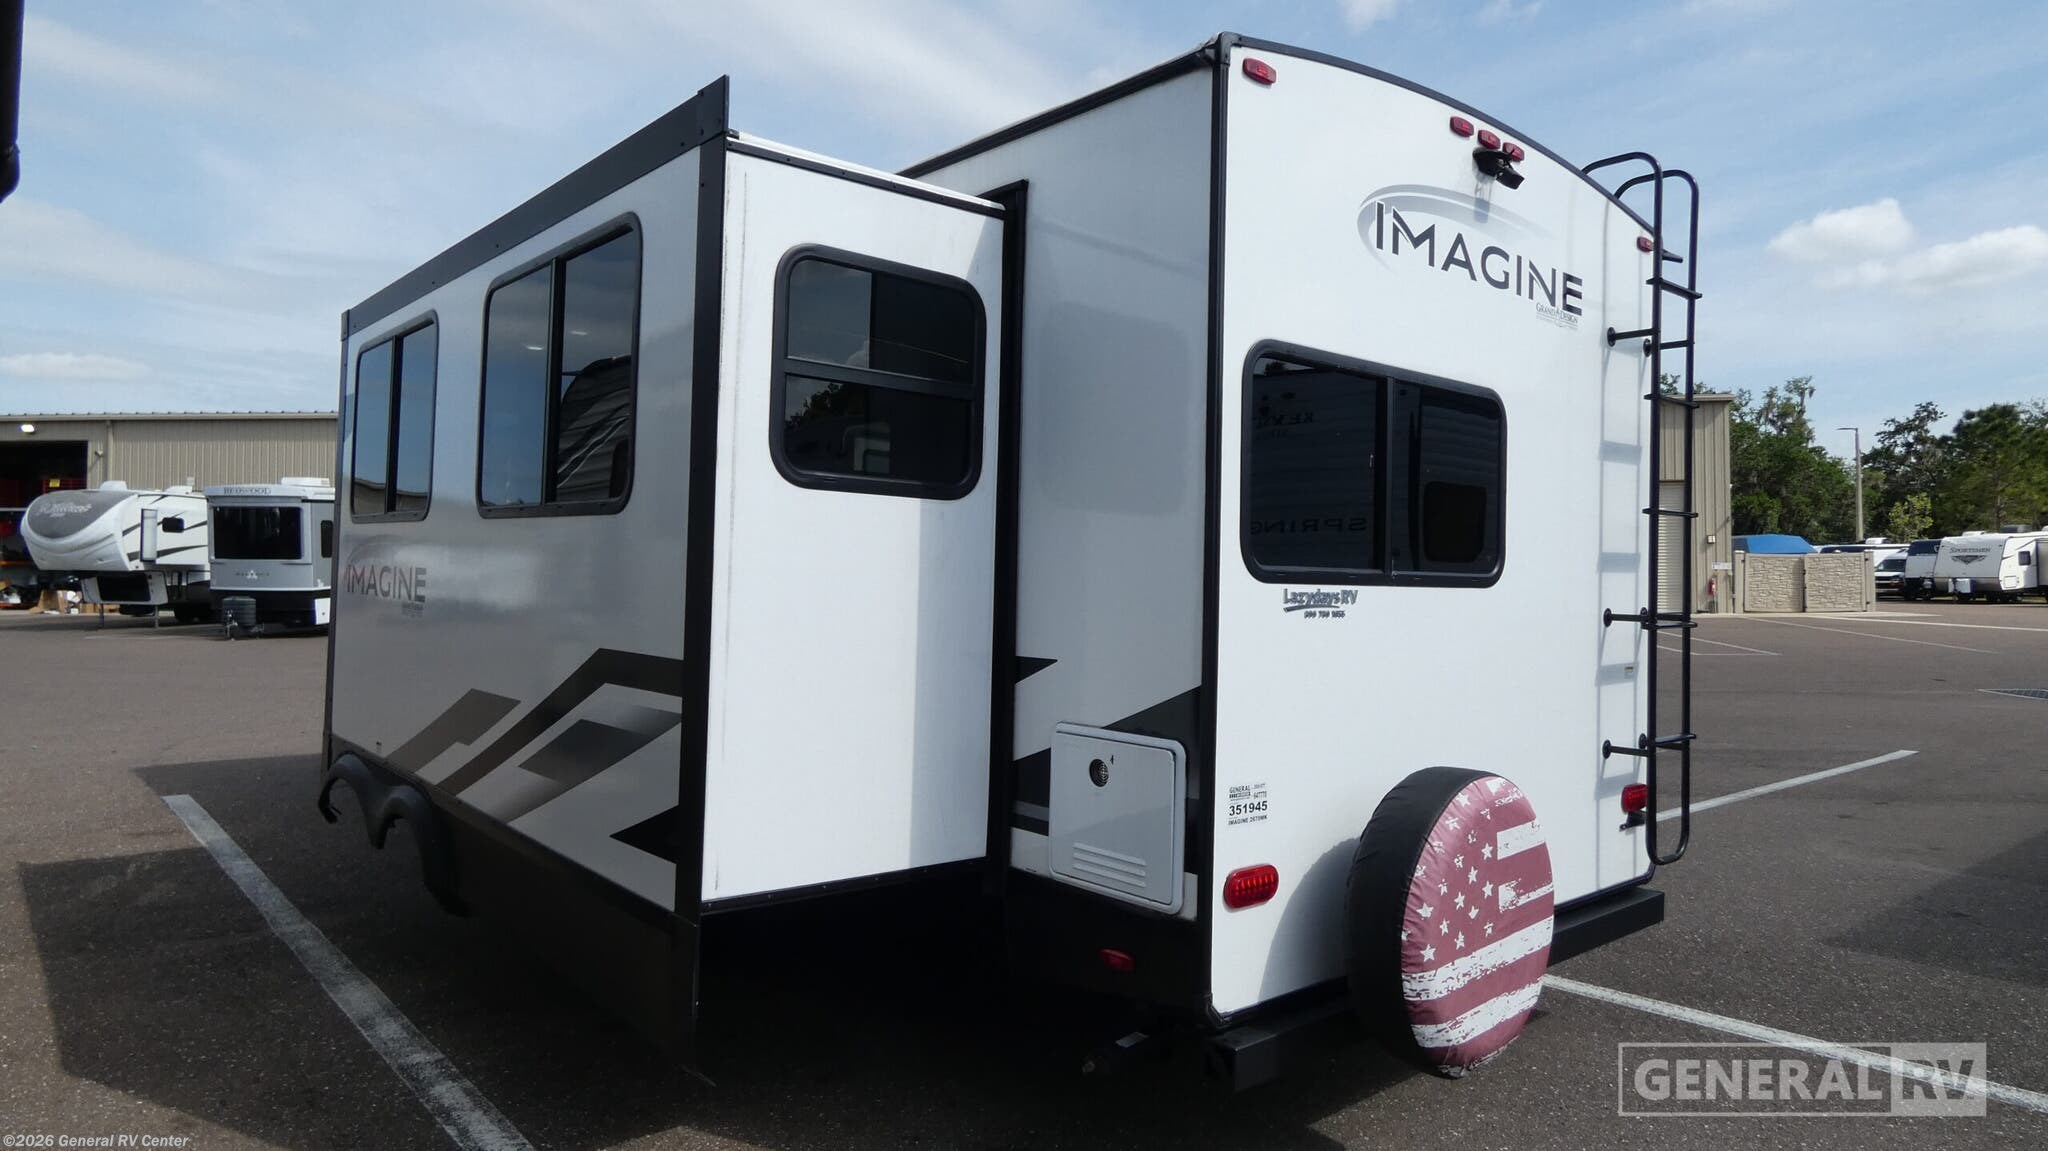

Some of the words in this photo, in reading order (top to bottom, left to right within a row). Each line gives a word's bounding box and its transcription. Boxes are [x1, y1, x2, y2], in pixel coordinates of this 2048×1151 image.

[1376, 201, 1583, 316] IMAGINE
[346, 564, 427, 603] IMAGINE
[1229, 800, 1268, 816] 351945
